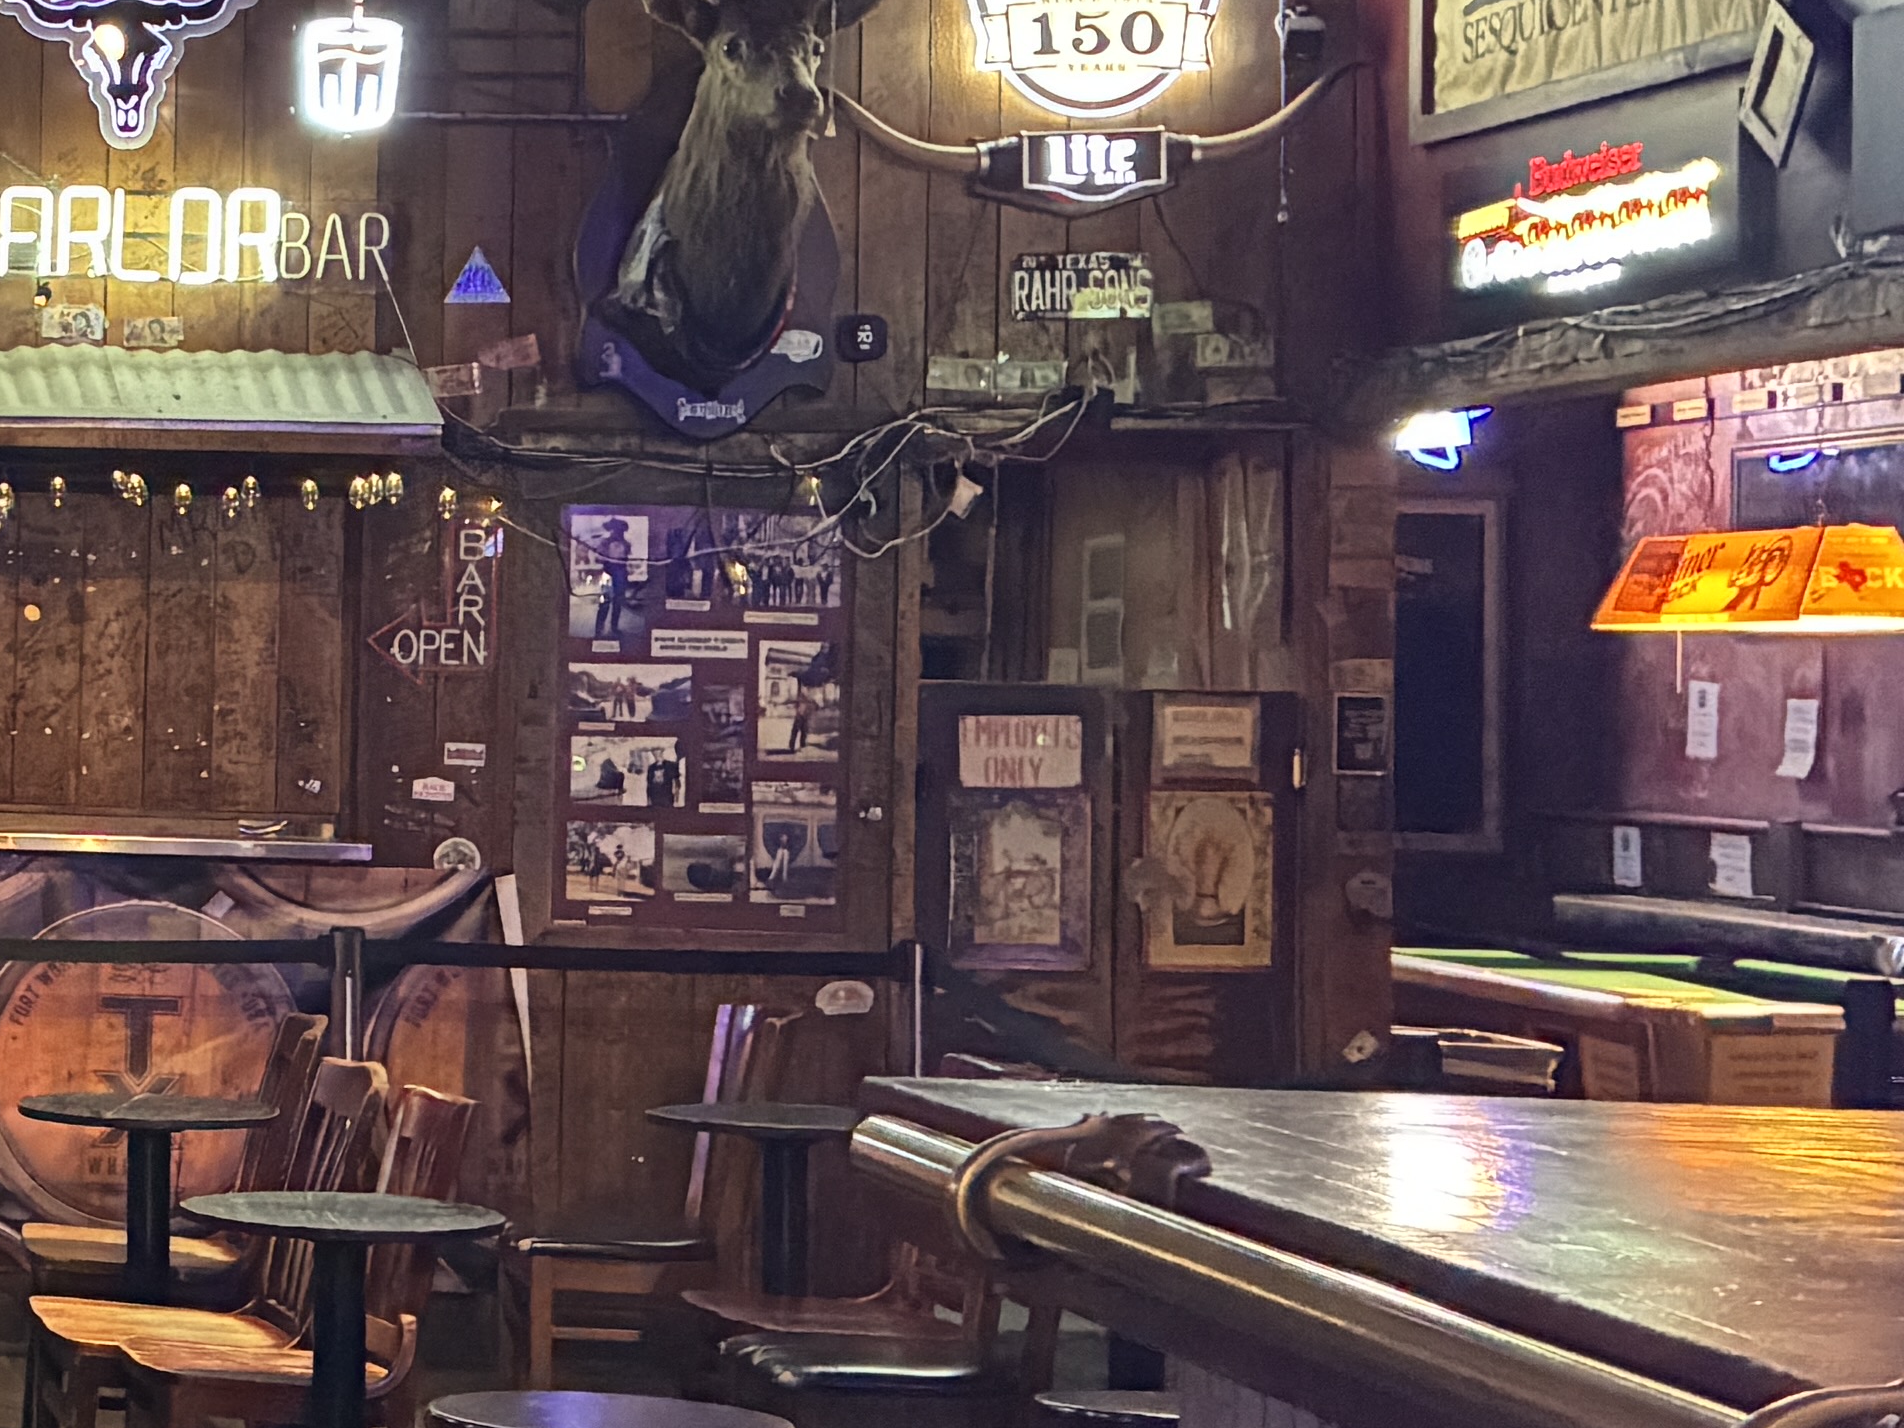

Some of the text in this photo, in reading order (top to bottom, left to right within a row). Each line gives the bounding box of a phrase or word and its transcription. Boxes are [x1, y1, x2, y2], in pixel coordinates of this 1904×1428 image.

[1031, 10, 1165, 57] 150
[1043, 135, 1138, 184] Lite
[1529, 140, 1644, 196] Budweiser
[280, 212, 391, 280] BAR
[1056, 254, 1111, 270] TEXAS
[455, 529, 486, 626] BAR
[1818, 562, 1904, 589] BCK
[393, 629, 486, 665] OPEN
[984, 756, 1045, 784] ONLY
[9, 985, 41, 1026] FORT
